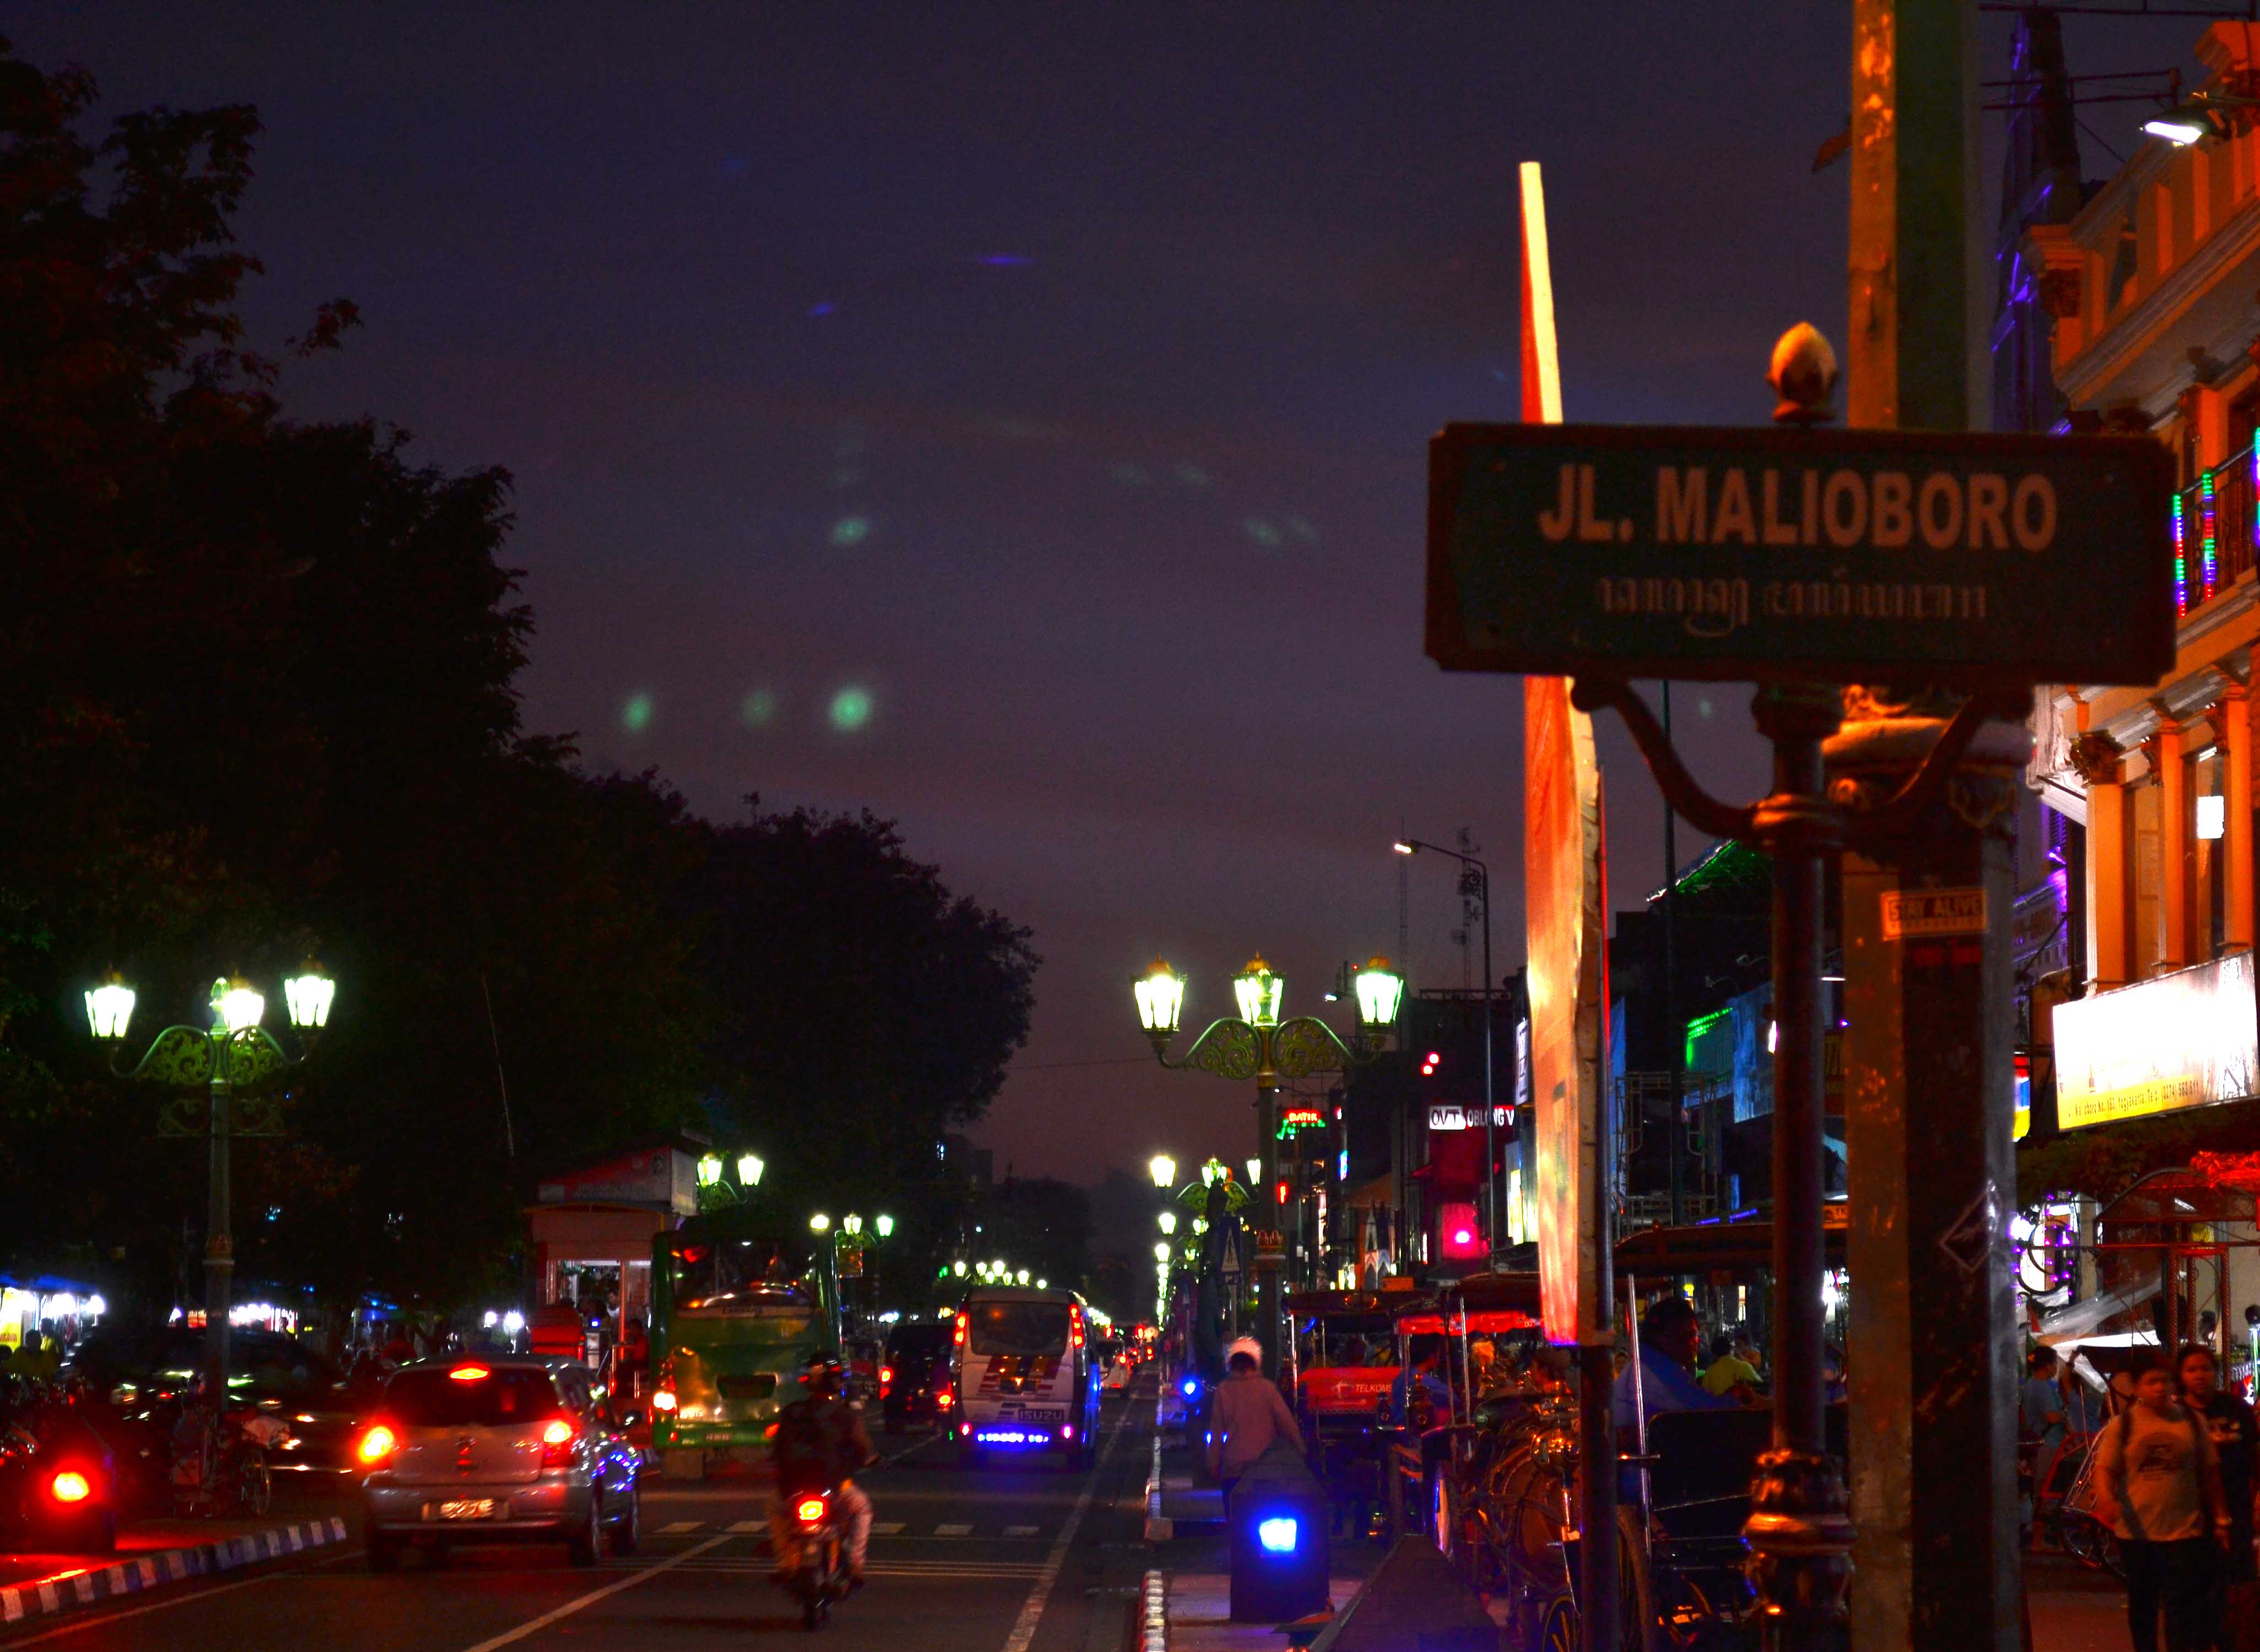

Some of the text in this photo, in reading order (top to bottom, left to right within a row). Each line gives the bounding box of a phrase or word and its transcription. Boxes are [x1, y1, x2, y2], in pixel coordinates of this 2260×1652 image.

[1540, 463, 2058, 550] JL. MALIOBORO
[1888, 893, 1982, 921] STAY ALIVE
[1019, 1410, 1063, 1420] ISUZU
